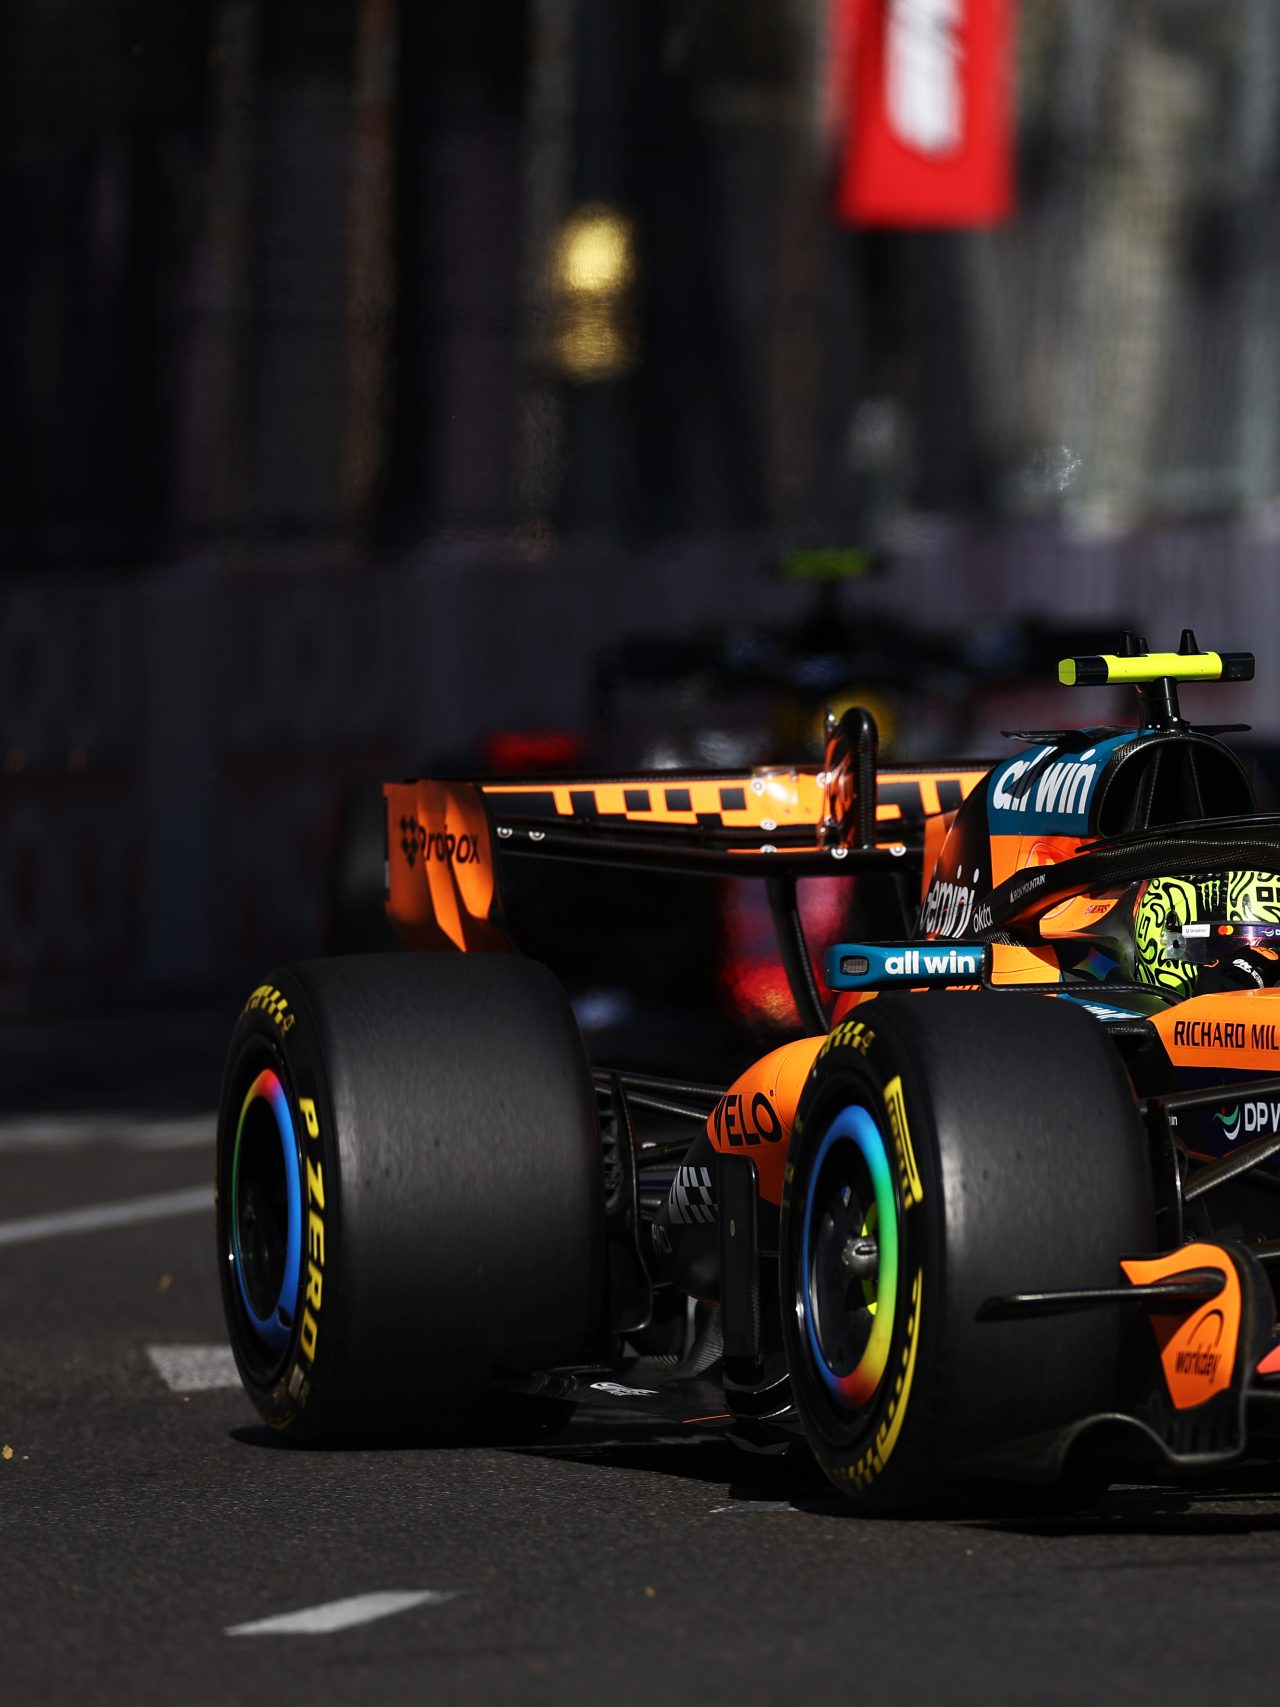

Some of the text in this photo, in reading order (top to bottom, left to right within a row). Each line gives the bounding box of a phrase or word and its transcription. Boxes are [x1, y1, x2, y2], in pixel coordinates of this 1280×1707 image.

[1035, 749, 1097, 814] win
[973, 903, 994, 933] okta
[884, 950, 976, 975] all win
[1174, 1020, 1246, 1049] RICHARD
[714, 1091, 783, 1148] VELO
[1245, 1102, 1268, 1132] DP
[1175, 1344, 1221, 1384] workday
